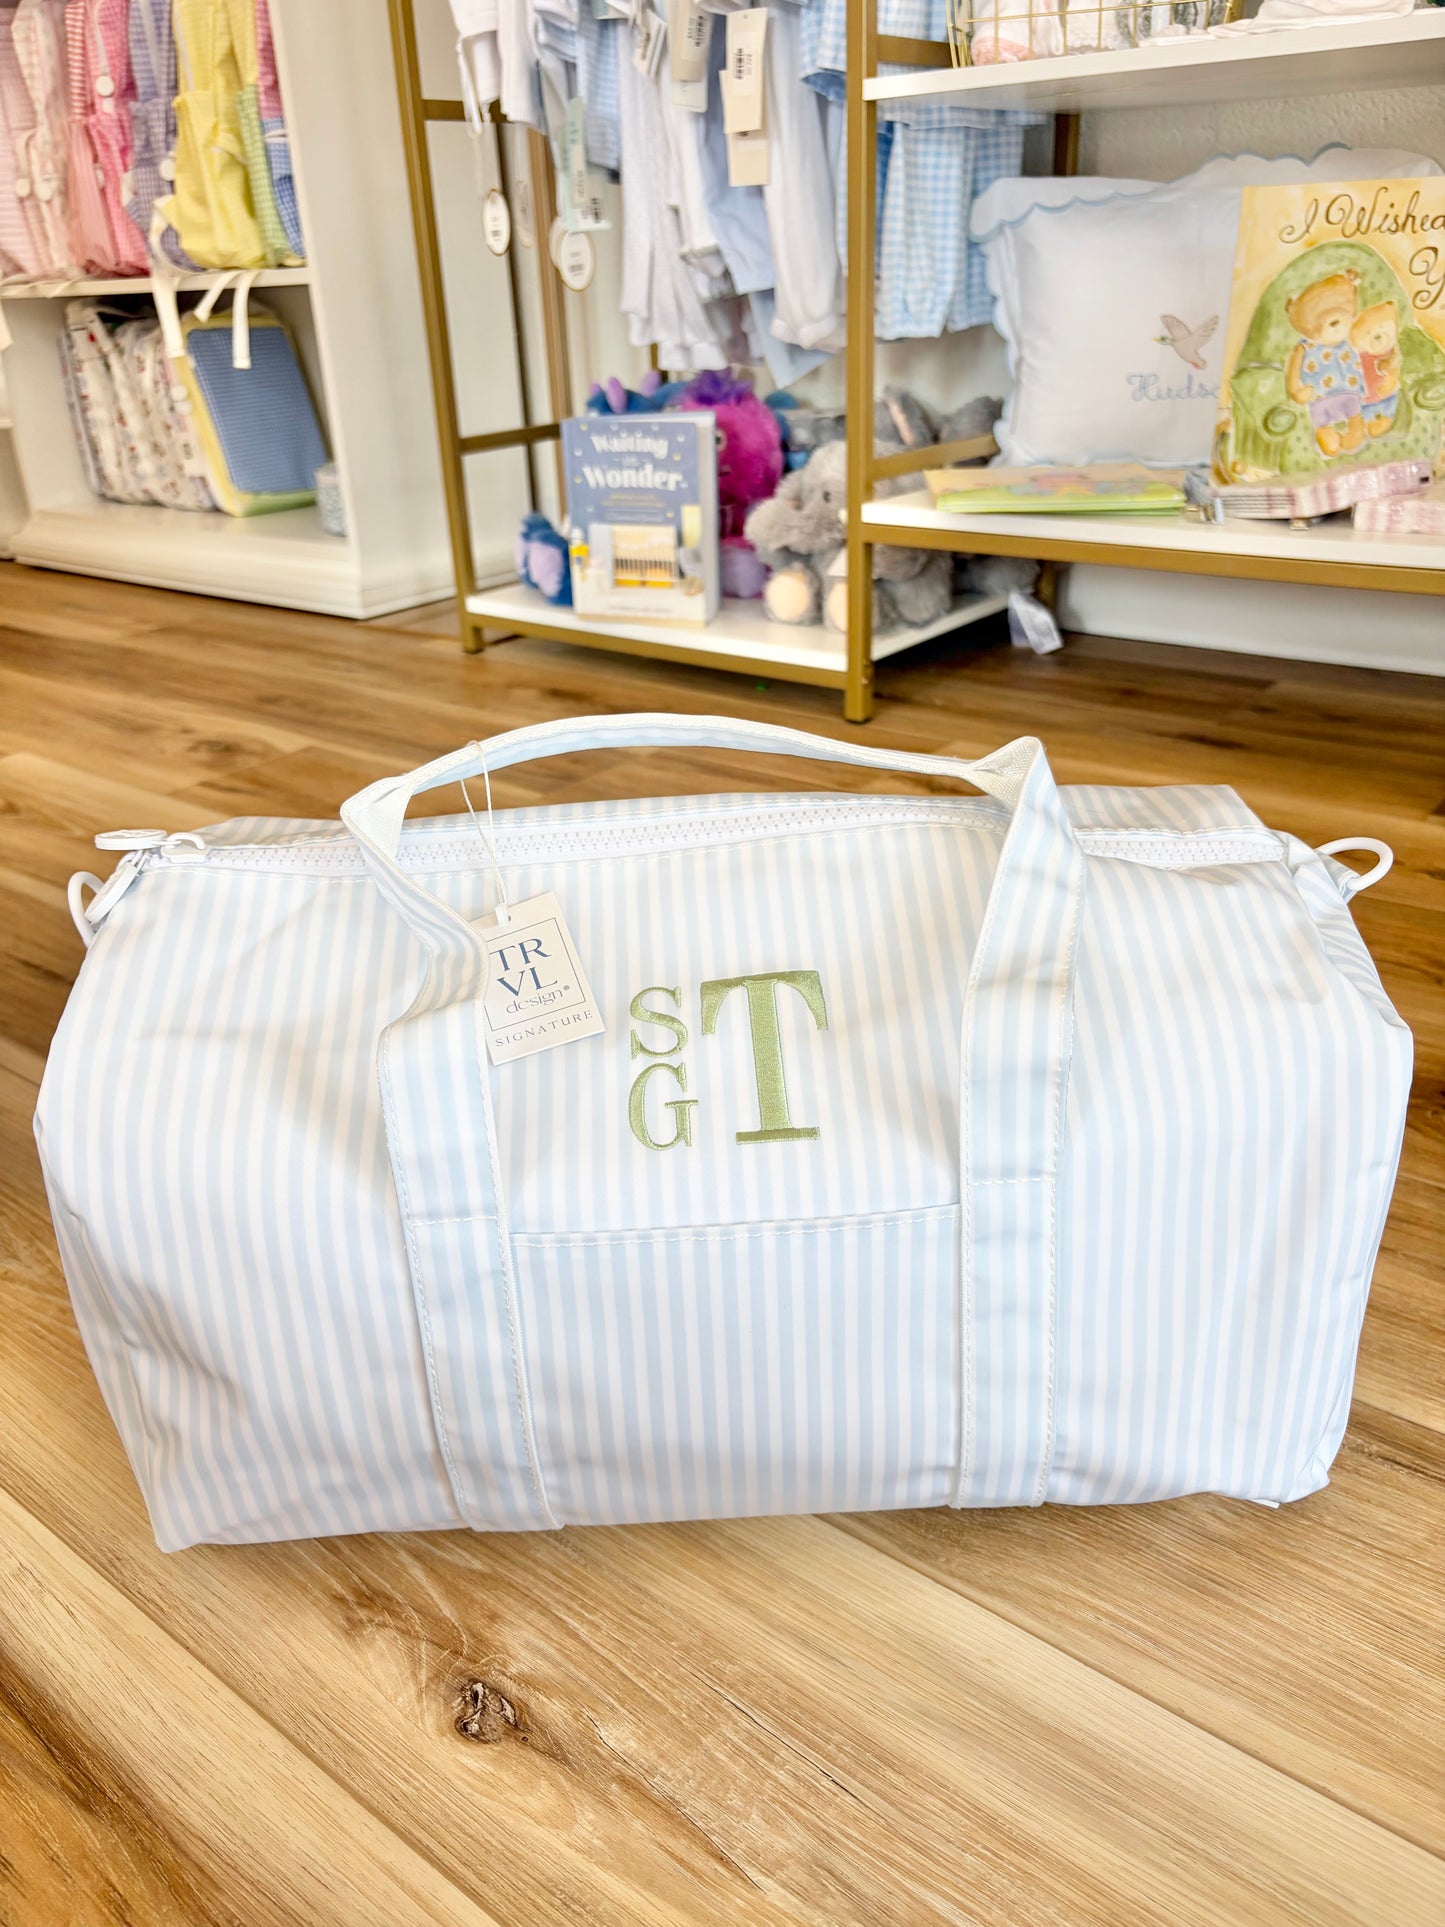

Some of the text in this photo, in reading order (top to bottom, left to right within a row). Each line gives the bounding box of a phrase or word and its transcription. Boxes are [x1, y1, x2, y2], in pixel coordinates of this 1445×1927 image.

[1278, 197, 1320, 244] I
[590, 432, 668, 460] Waiting
[582, 463, 683, 491] Wonder
[488, 938, 552, 972] TR
[496, 966, 558, 997] VL
[494, 1009, 593, 1047] SIGNATURE
[629, 985, 689, 1060] S
[699, 969, 829, 1145] T
[628, 1061, 699, 1151] G
